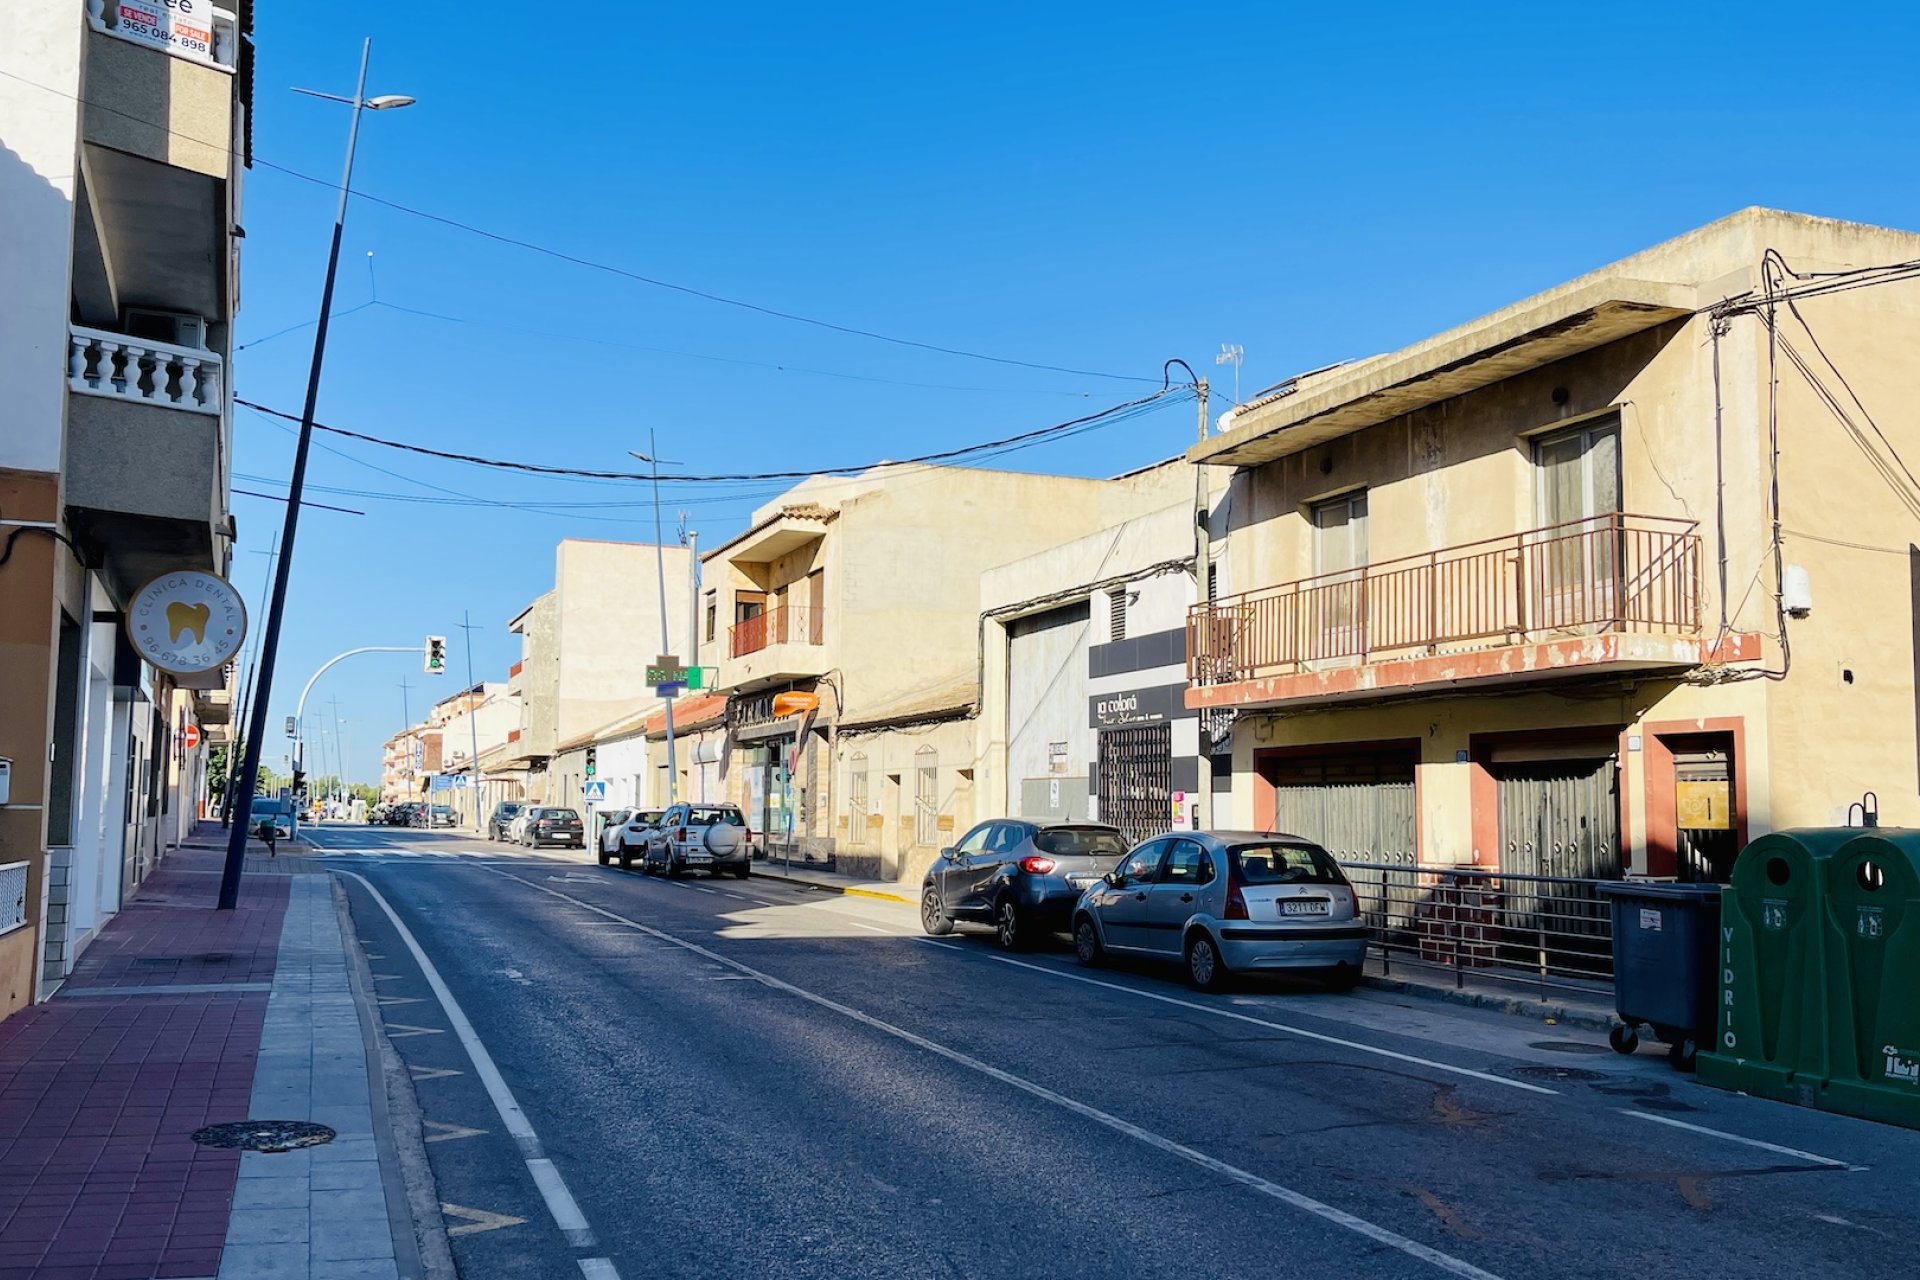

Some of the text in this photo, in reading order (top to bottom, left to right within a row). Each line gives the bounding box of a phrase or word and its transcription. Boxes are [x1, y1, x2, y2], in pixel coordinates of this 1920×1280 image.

[123, 18, 148, 34] 965
[151, 27, 177, 43] 084
[181, 37, 206, 52] 898
[195, 579, 236, 621] DENTAL
[142, 636, 229, 666] 96 678 36 45
[1723, 927, 1737, 1049] VIDRIO
